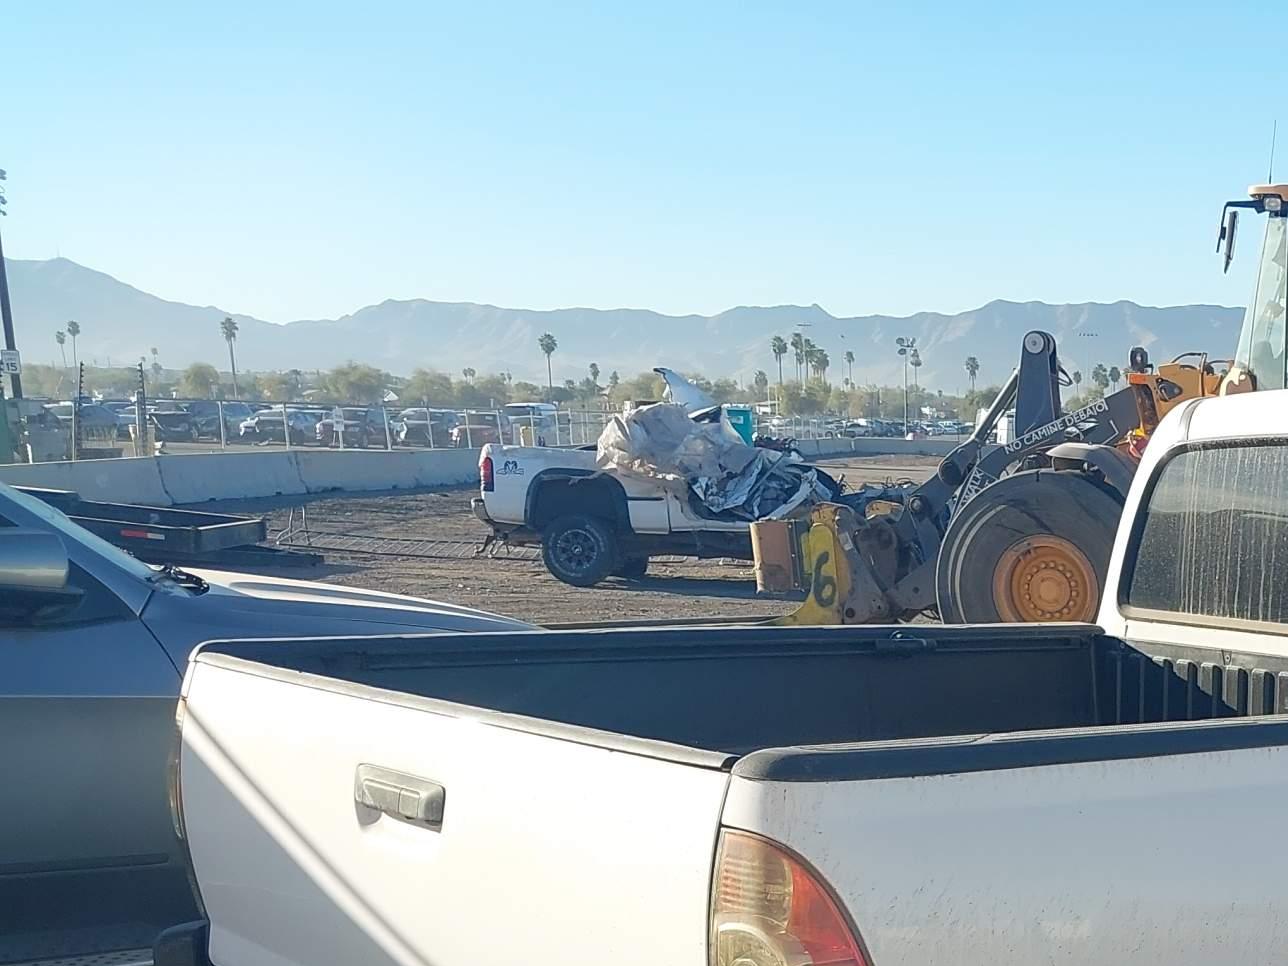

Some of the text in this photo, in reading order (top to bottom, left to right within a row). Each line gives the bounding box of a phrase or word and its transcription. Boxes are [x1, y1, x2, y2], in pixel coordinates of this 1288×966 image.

[6, 362, 17, 371] 15
[1004, 402, 1105, 454] NO CAMINE DEBAJO
[813, 551, 836, 608] 6
